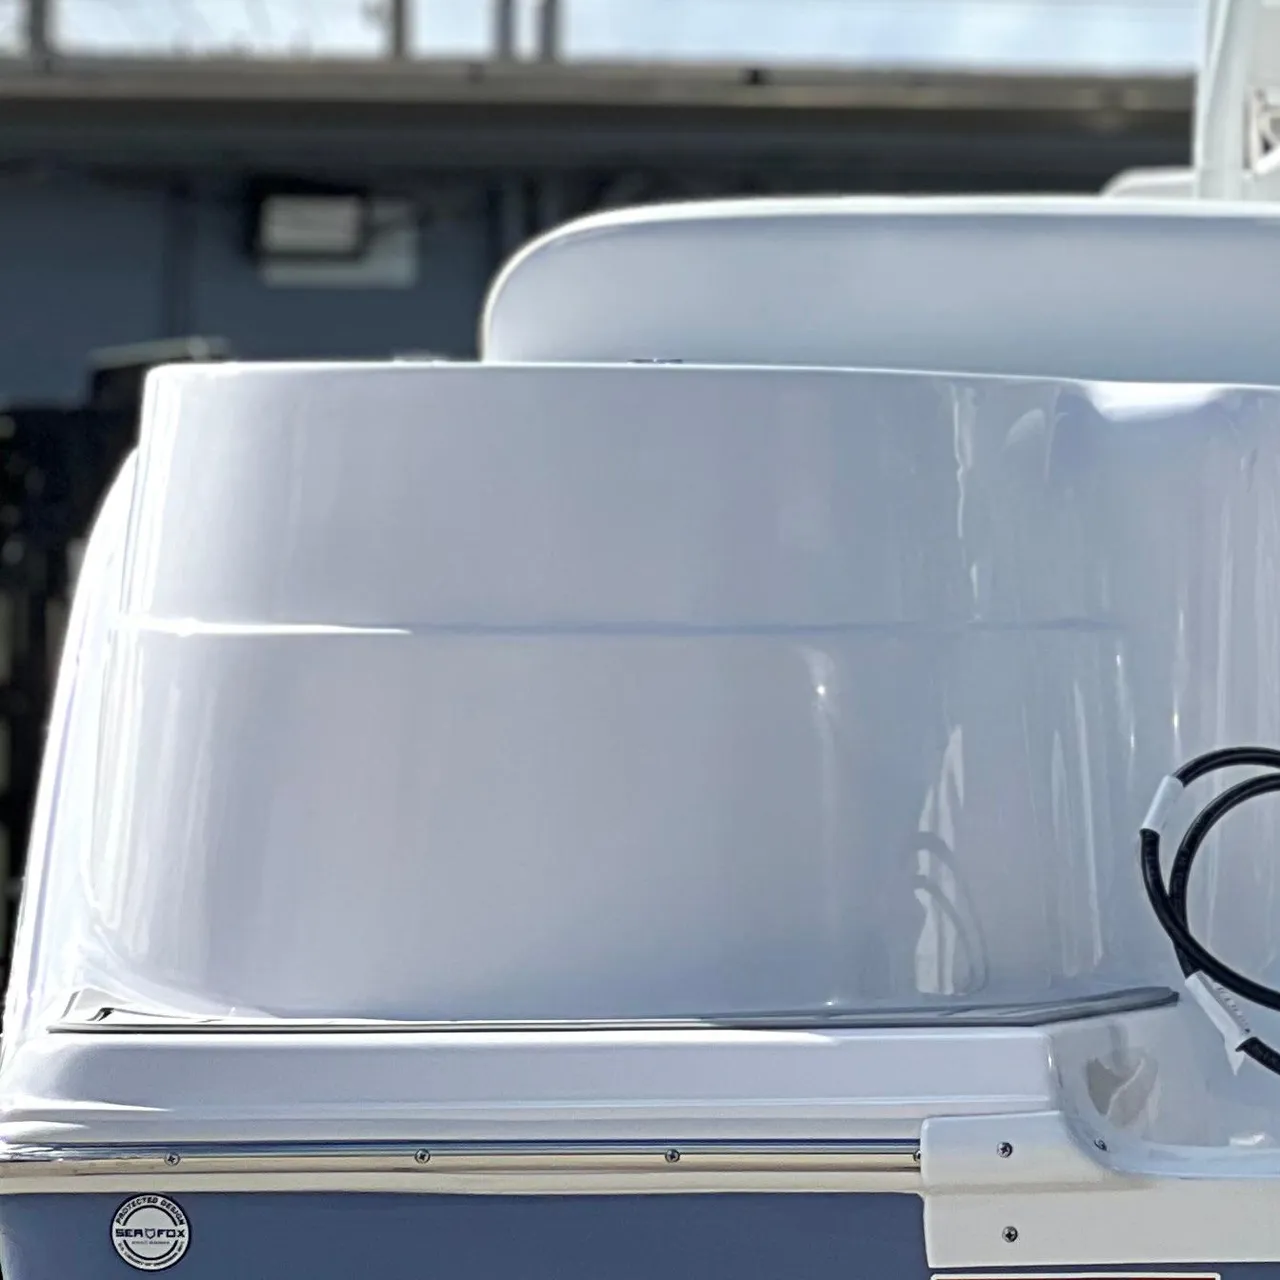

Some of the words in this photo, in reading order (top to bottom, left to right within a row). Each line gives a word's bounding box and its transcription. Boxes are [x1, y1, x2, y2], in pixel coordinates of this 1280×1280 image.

[116, 1196, 159, 1225] PROTECTED
[160, 1199, 185, 1225] DESIGN
[115, 1229, 143, 1238] SEA
[157, 1229, 185, 1238] FOX
